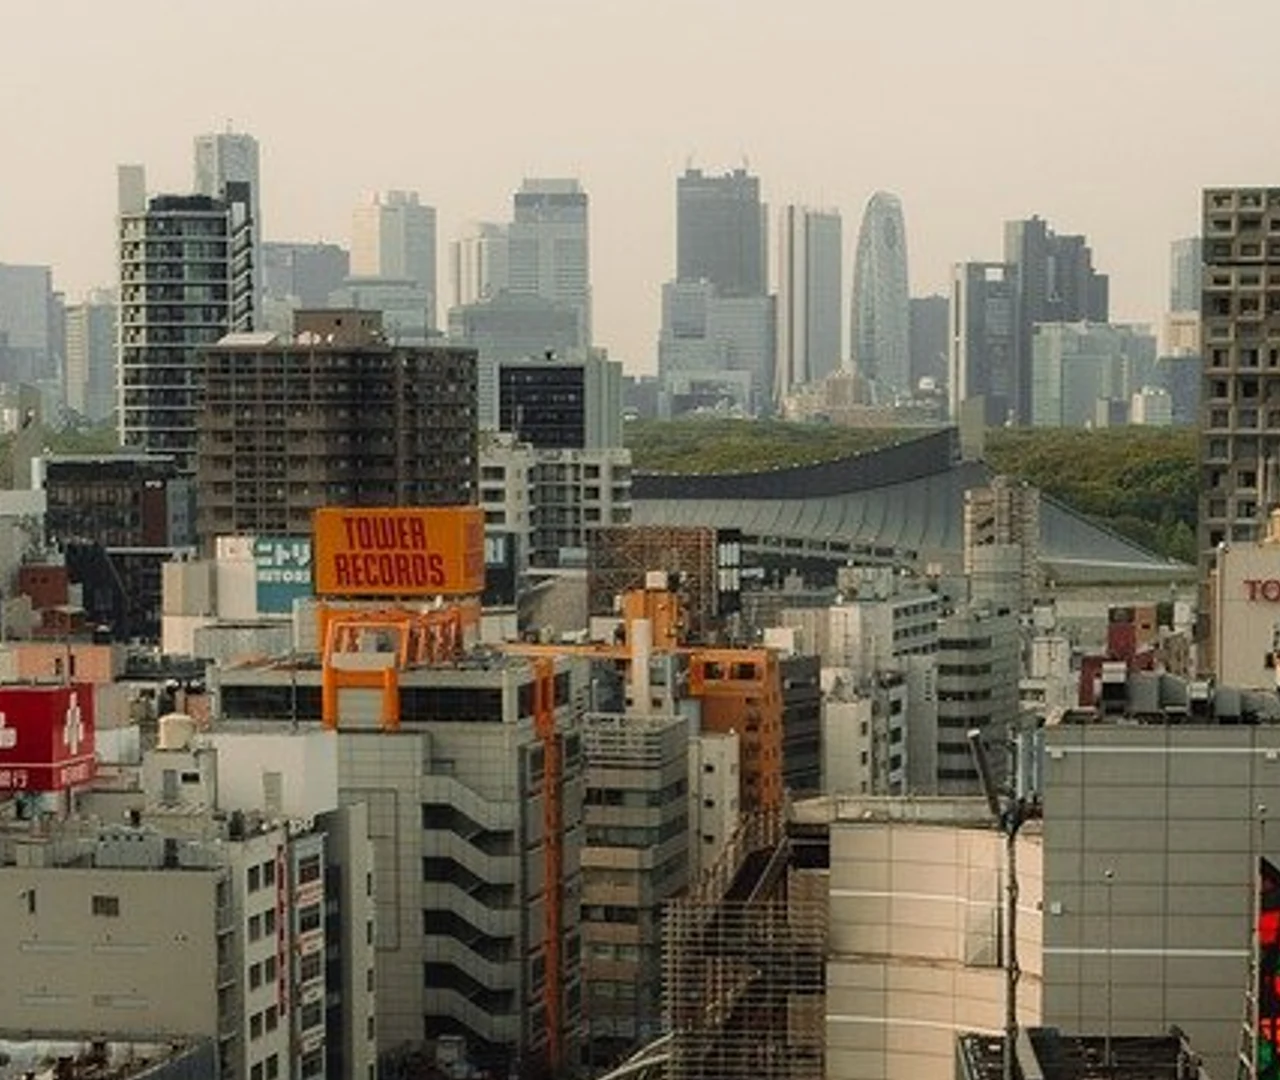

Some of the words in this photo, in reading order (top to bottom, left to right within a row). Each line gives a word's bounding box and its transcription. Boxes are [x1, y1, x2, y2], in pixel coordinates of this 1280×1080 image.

[342, 516, 427, 550] TOWER
[257, 542, 311, 567] ニトリ
[333, 553, 445, 588] RECORDS
